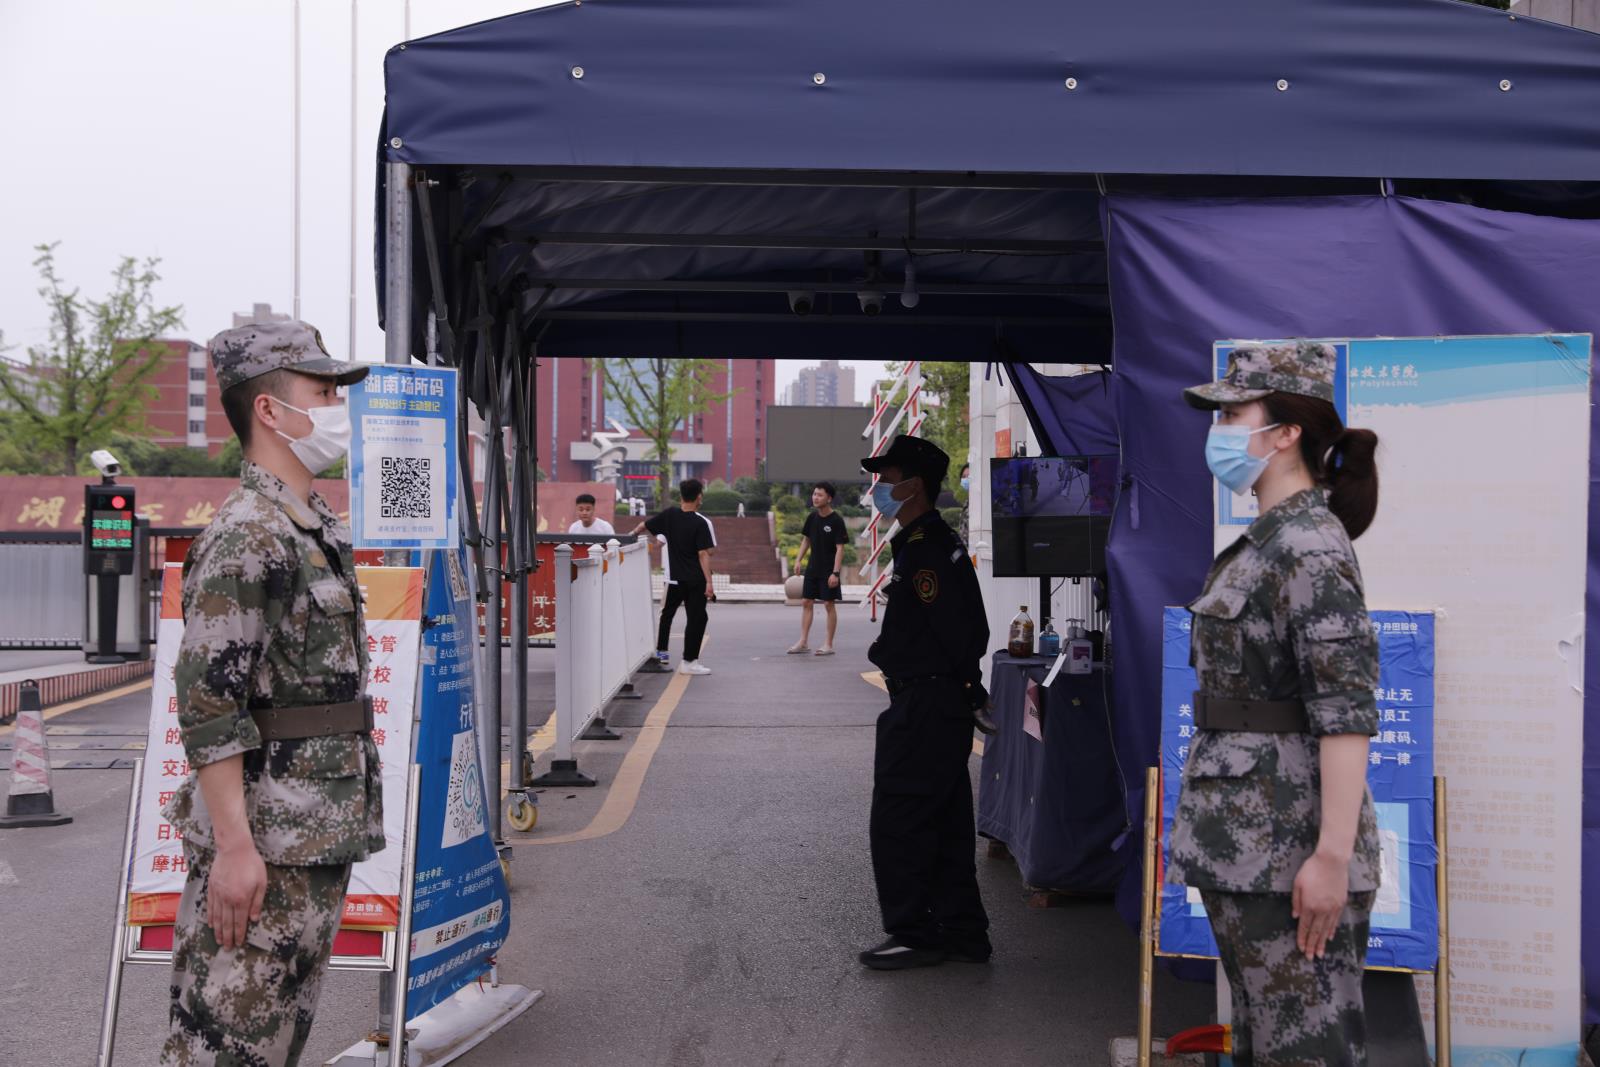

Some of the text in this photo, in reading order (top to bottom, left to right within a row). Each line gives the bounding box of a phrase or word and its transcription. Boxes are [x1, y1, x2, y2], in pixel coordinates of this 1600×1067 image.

[364, 374, 444, 397] 湖南场所码
[1360, 380, 1418, 388] Polytechnic
[534, 615, 556, 629] 友
[1178, 704, 1192, 717] 关
[1376, 709, 1411, 722] 员工
[1369, 751, 1411, 766] 者一律
[151, 855, 189, 873] 摩托
[346, 902, 383, 912] 丹田物业
